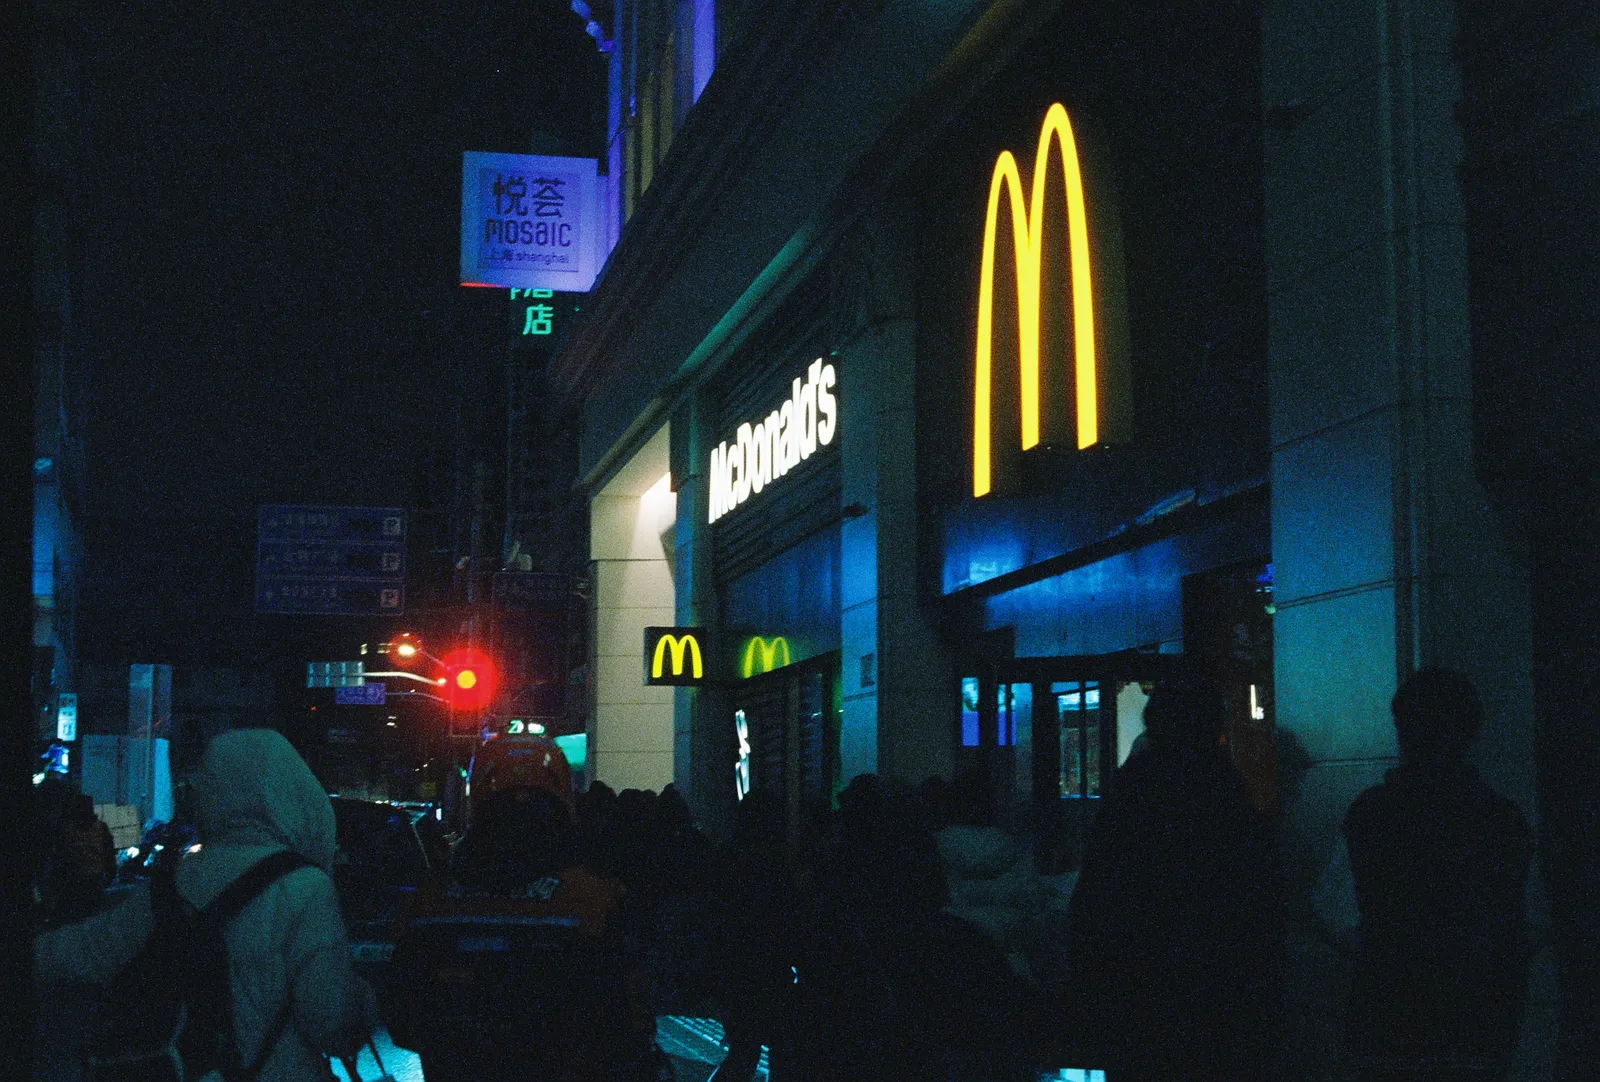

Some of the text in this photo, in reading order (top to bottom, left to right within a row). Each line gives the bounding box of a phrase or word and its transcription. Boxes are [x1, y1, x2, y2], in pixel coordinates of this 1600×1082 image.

[492, 174, 567, 218] 悦荟
[516, 248, 570, 266] shanghai
[708, 357, 837, 524] McDonald's
